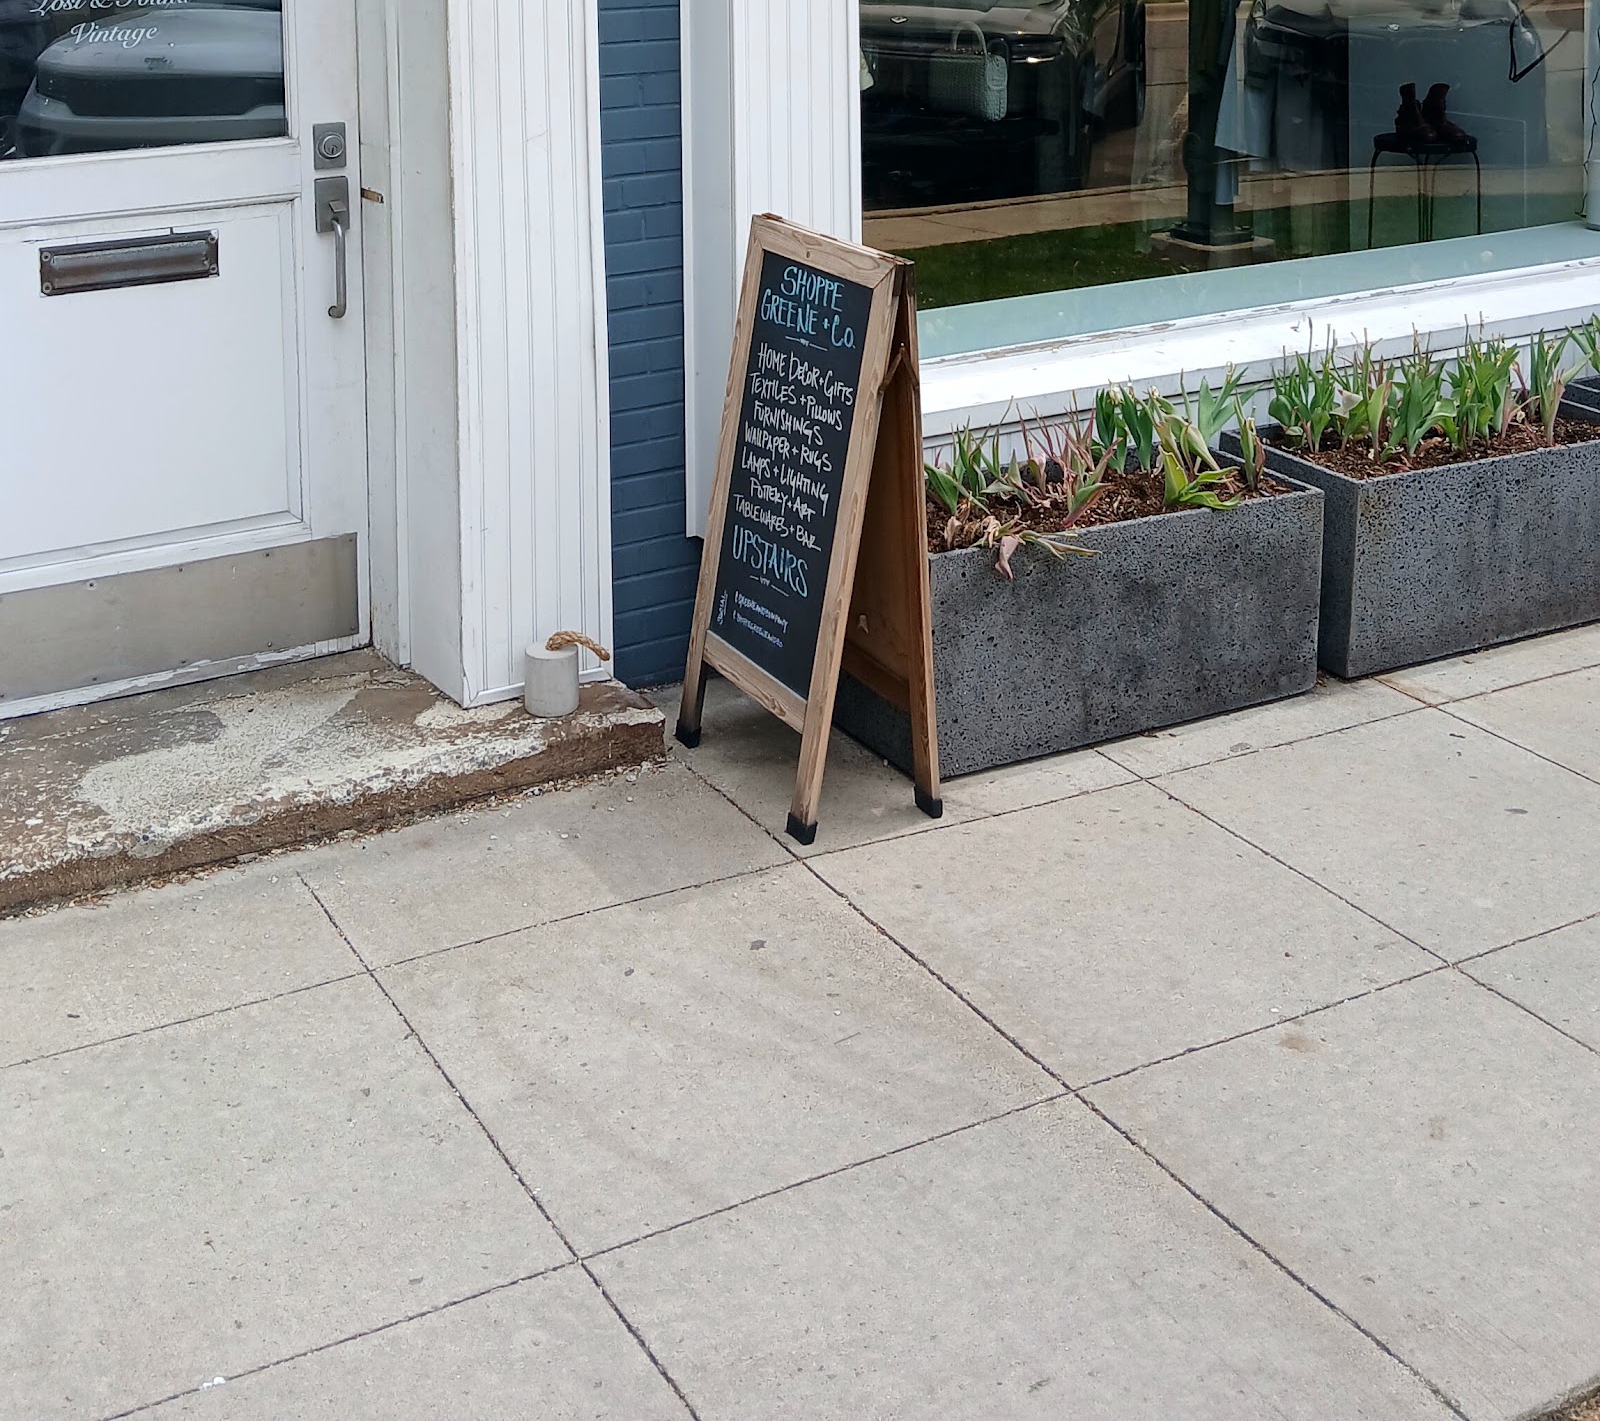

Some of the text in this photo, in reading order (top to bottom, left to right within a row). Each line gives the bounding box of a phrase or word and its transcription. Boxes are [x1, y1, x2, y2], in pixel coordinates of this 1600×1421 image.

[70, 22, 159, 49] Vintage
[780, 266, 845, 312] SHOPPE
[761, 289, 818, 335] GREENE
[758, 342, 787, 377] HOME
[749, 372, 797, 405] TEXTILES
[754, 400, 824, 446] FURNISHINGS
[800, 444, 832, 473] RUGS
[741, 446, 771, 480] LAMPS
[780, 463, 829, 517] LIGHTING
[750, 477, 788, 516] POTTERY
[732, 525, 809, 598] UPSTAIRS
